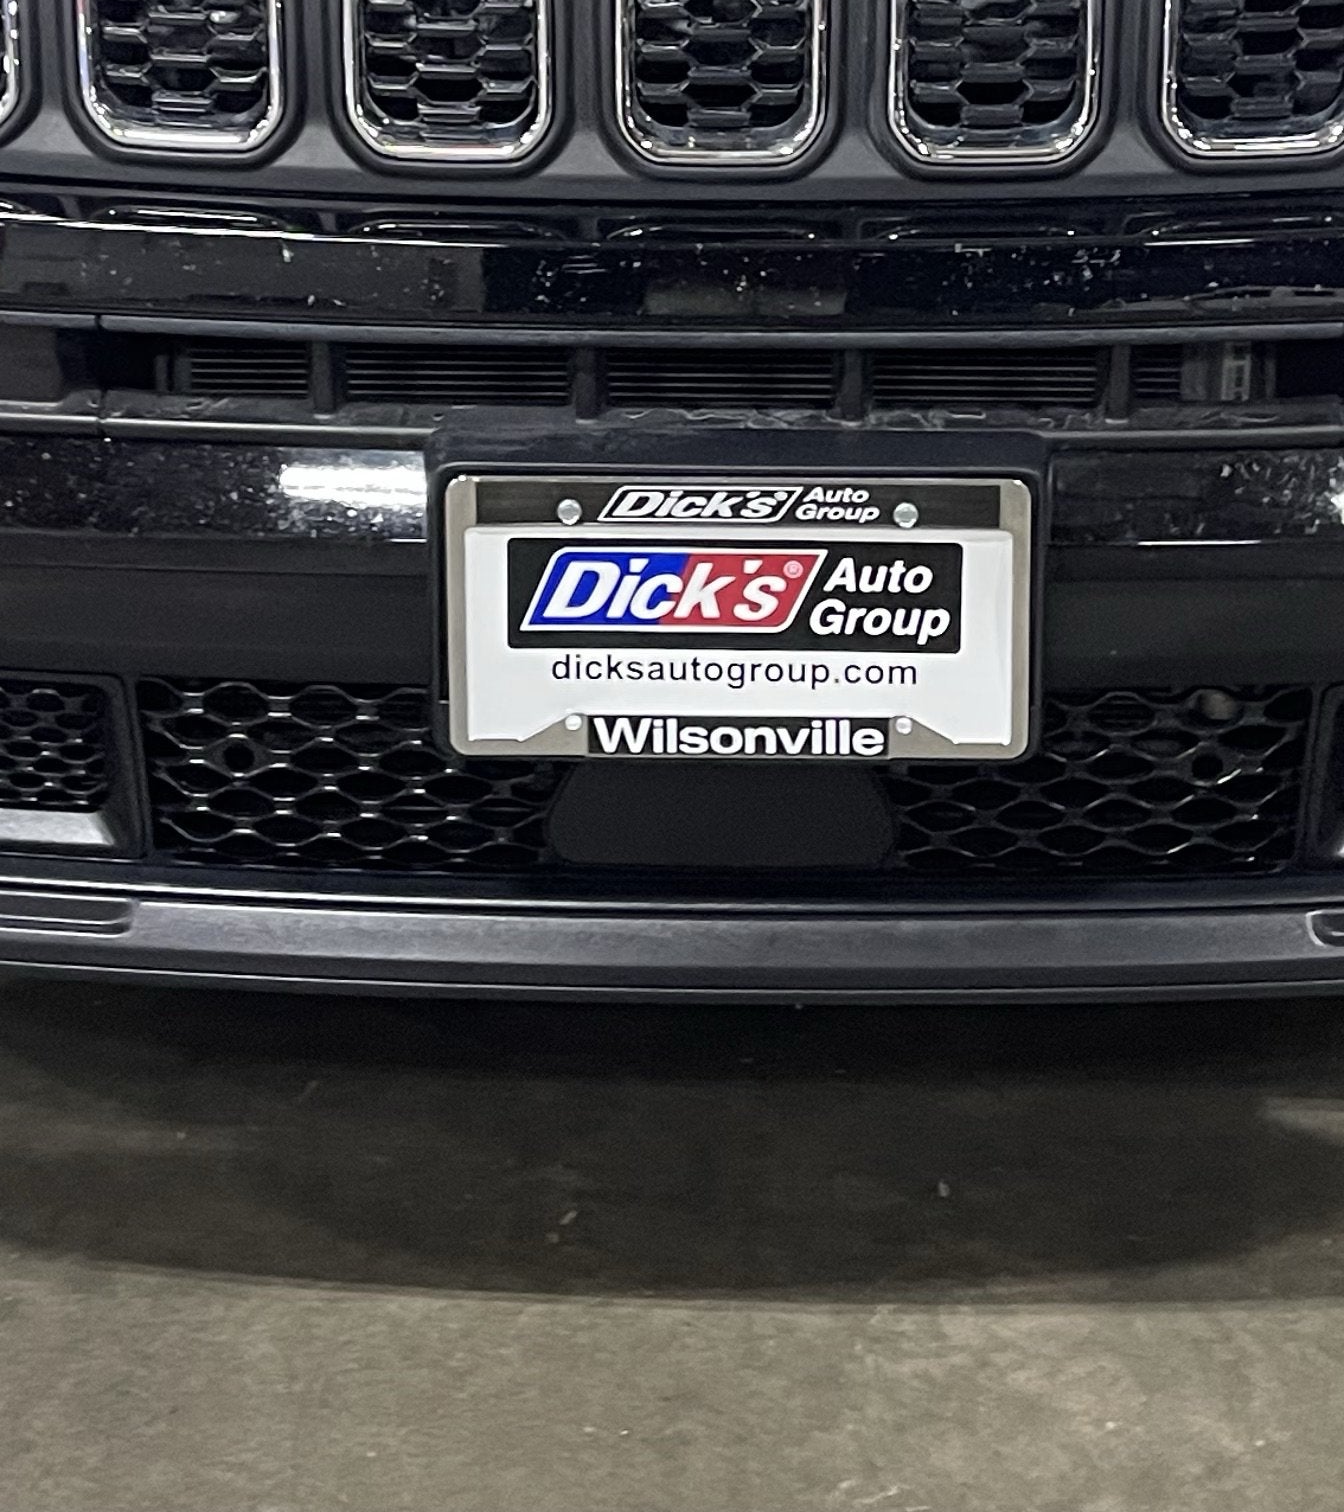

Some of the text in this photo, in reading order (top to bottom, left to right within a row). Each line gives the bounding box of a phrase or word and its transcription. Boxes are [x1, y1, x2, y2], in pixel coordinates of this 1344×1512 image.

[795, 503, 880, 524] Group
[803, 487, 870, 504] Auto
[822, 557, 934, 594] Auto
[809, 597, 951, 646] Group
[551, 654, 918, 690] dicksautogroup.com
[592, 716, 885, 756] Wilsonville
